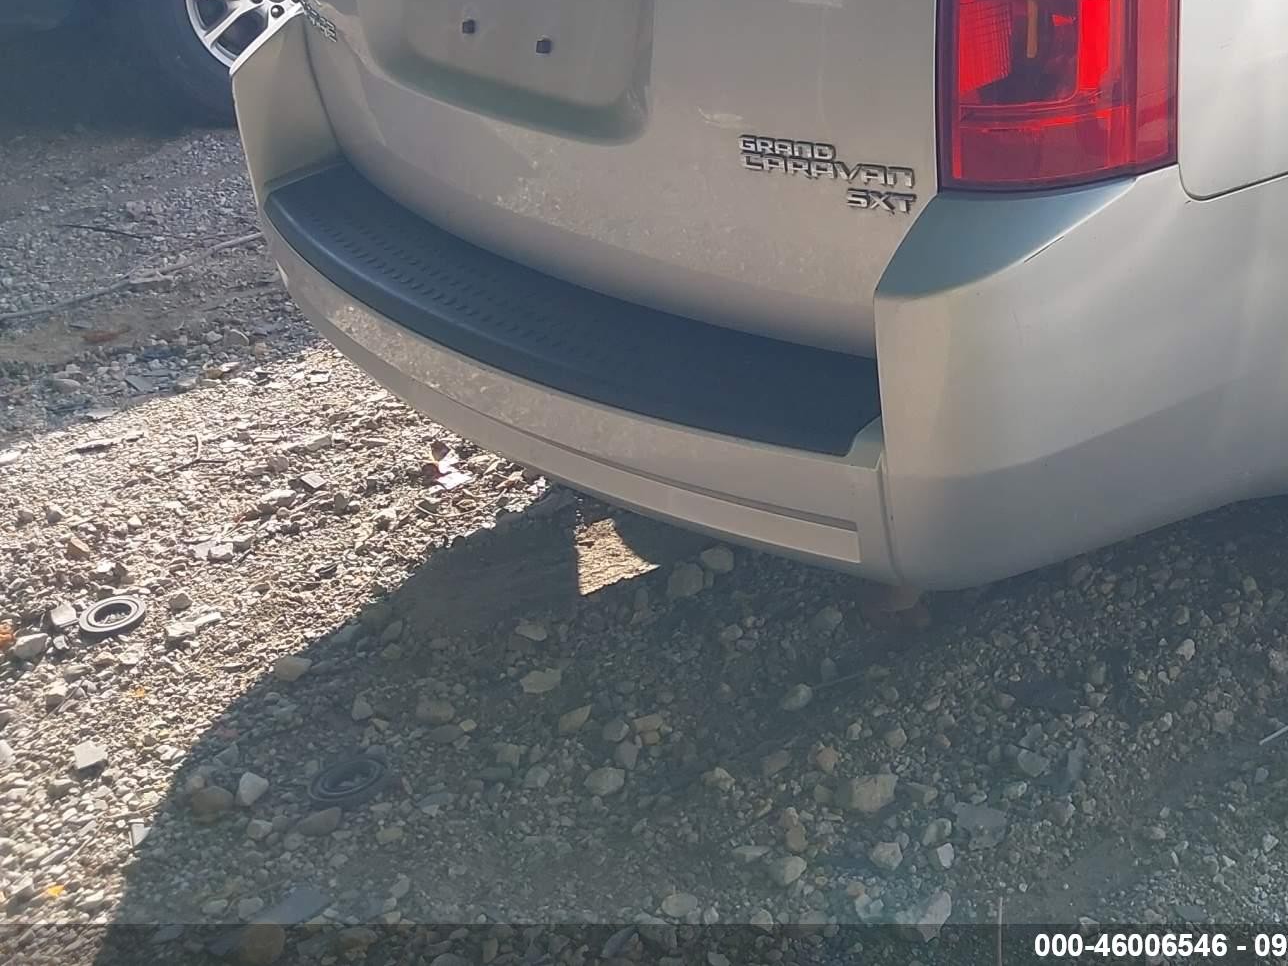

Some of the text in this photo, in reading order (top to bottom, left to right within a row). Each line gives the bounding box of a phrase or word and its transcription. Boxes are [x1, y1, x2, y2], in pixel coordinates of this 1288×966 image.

[738, 135, 836, 161] GRAND
[742, 153, 915, 187] CARAVAN
[846, 189, 917, 214] SXT
